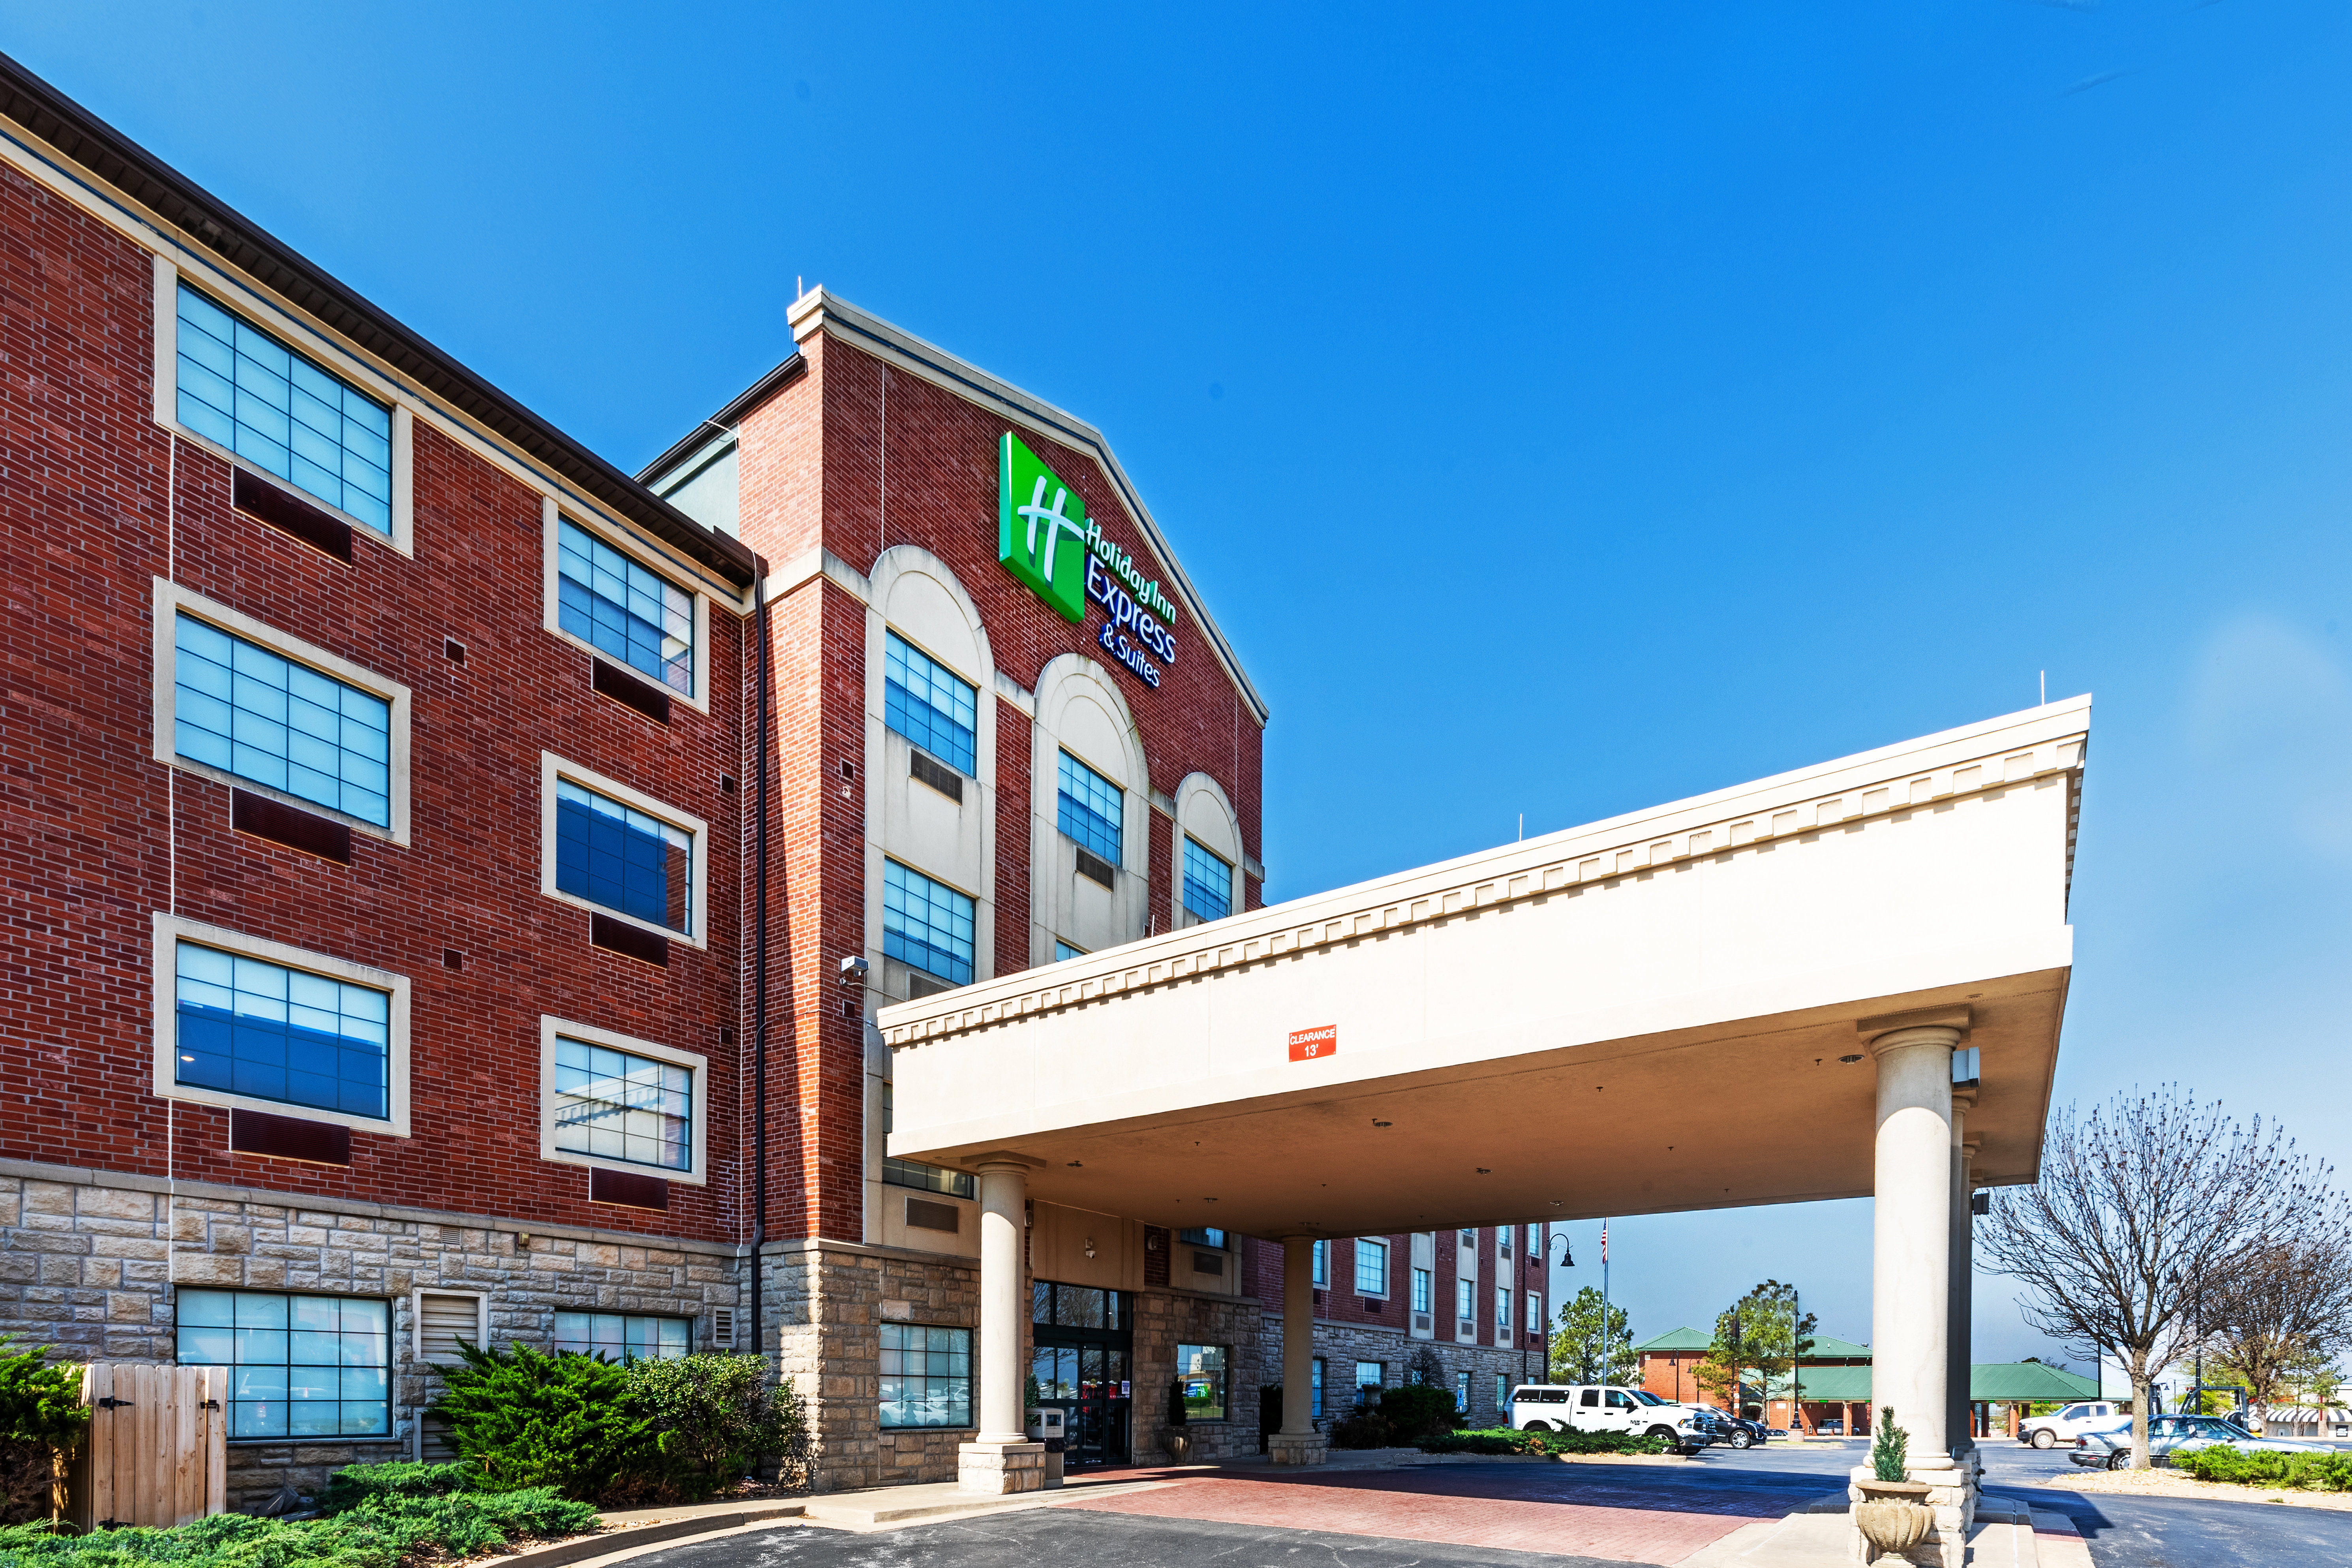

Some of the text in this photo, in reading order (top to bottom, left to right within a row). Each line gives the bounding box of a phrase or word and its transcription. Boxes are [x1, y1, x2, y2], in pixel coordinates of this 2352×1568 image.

[1086, 517, 1176, 624] Holiday Inn
[1087, 553, 1176, 663] Express
[1104, 623, 1160, 687] & Suites
[1290, 1028, 1335, 1045] CLEARANCE
